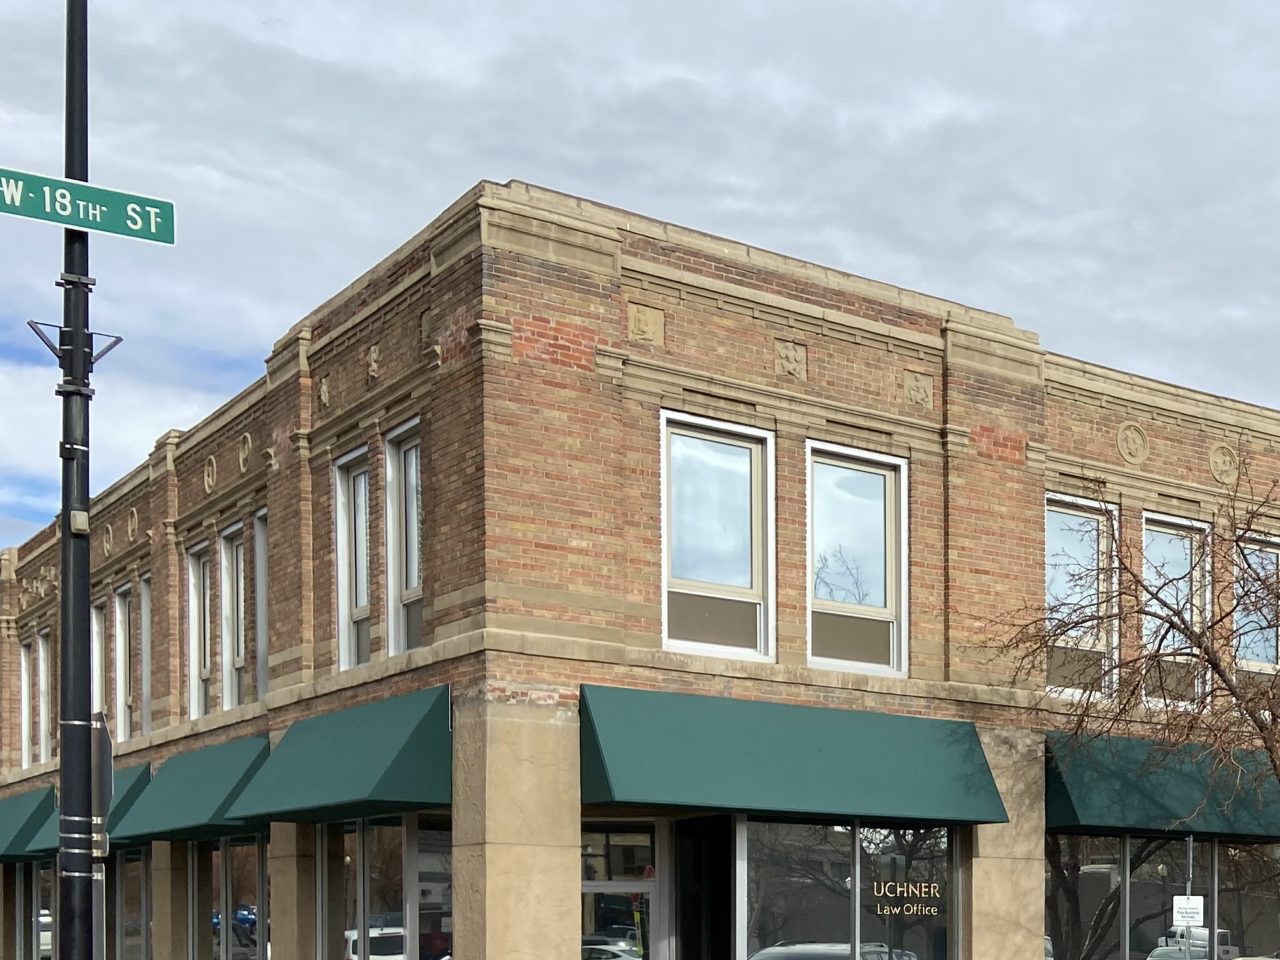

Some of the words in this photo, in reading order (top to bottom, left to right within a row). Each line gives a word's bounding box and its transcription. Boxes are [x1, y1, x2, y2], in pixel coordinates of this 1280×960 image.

[1, 177, 23, 207] W
[42, 185, 101, 223] 18TH
[126, 203, 160, 233] ST
[873, 881, 940, 898] UCHNER
[877, 903, 901, 915] Law
[903, 903, 938, 915] Office
